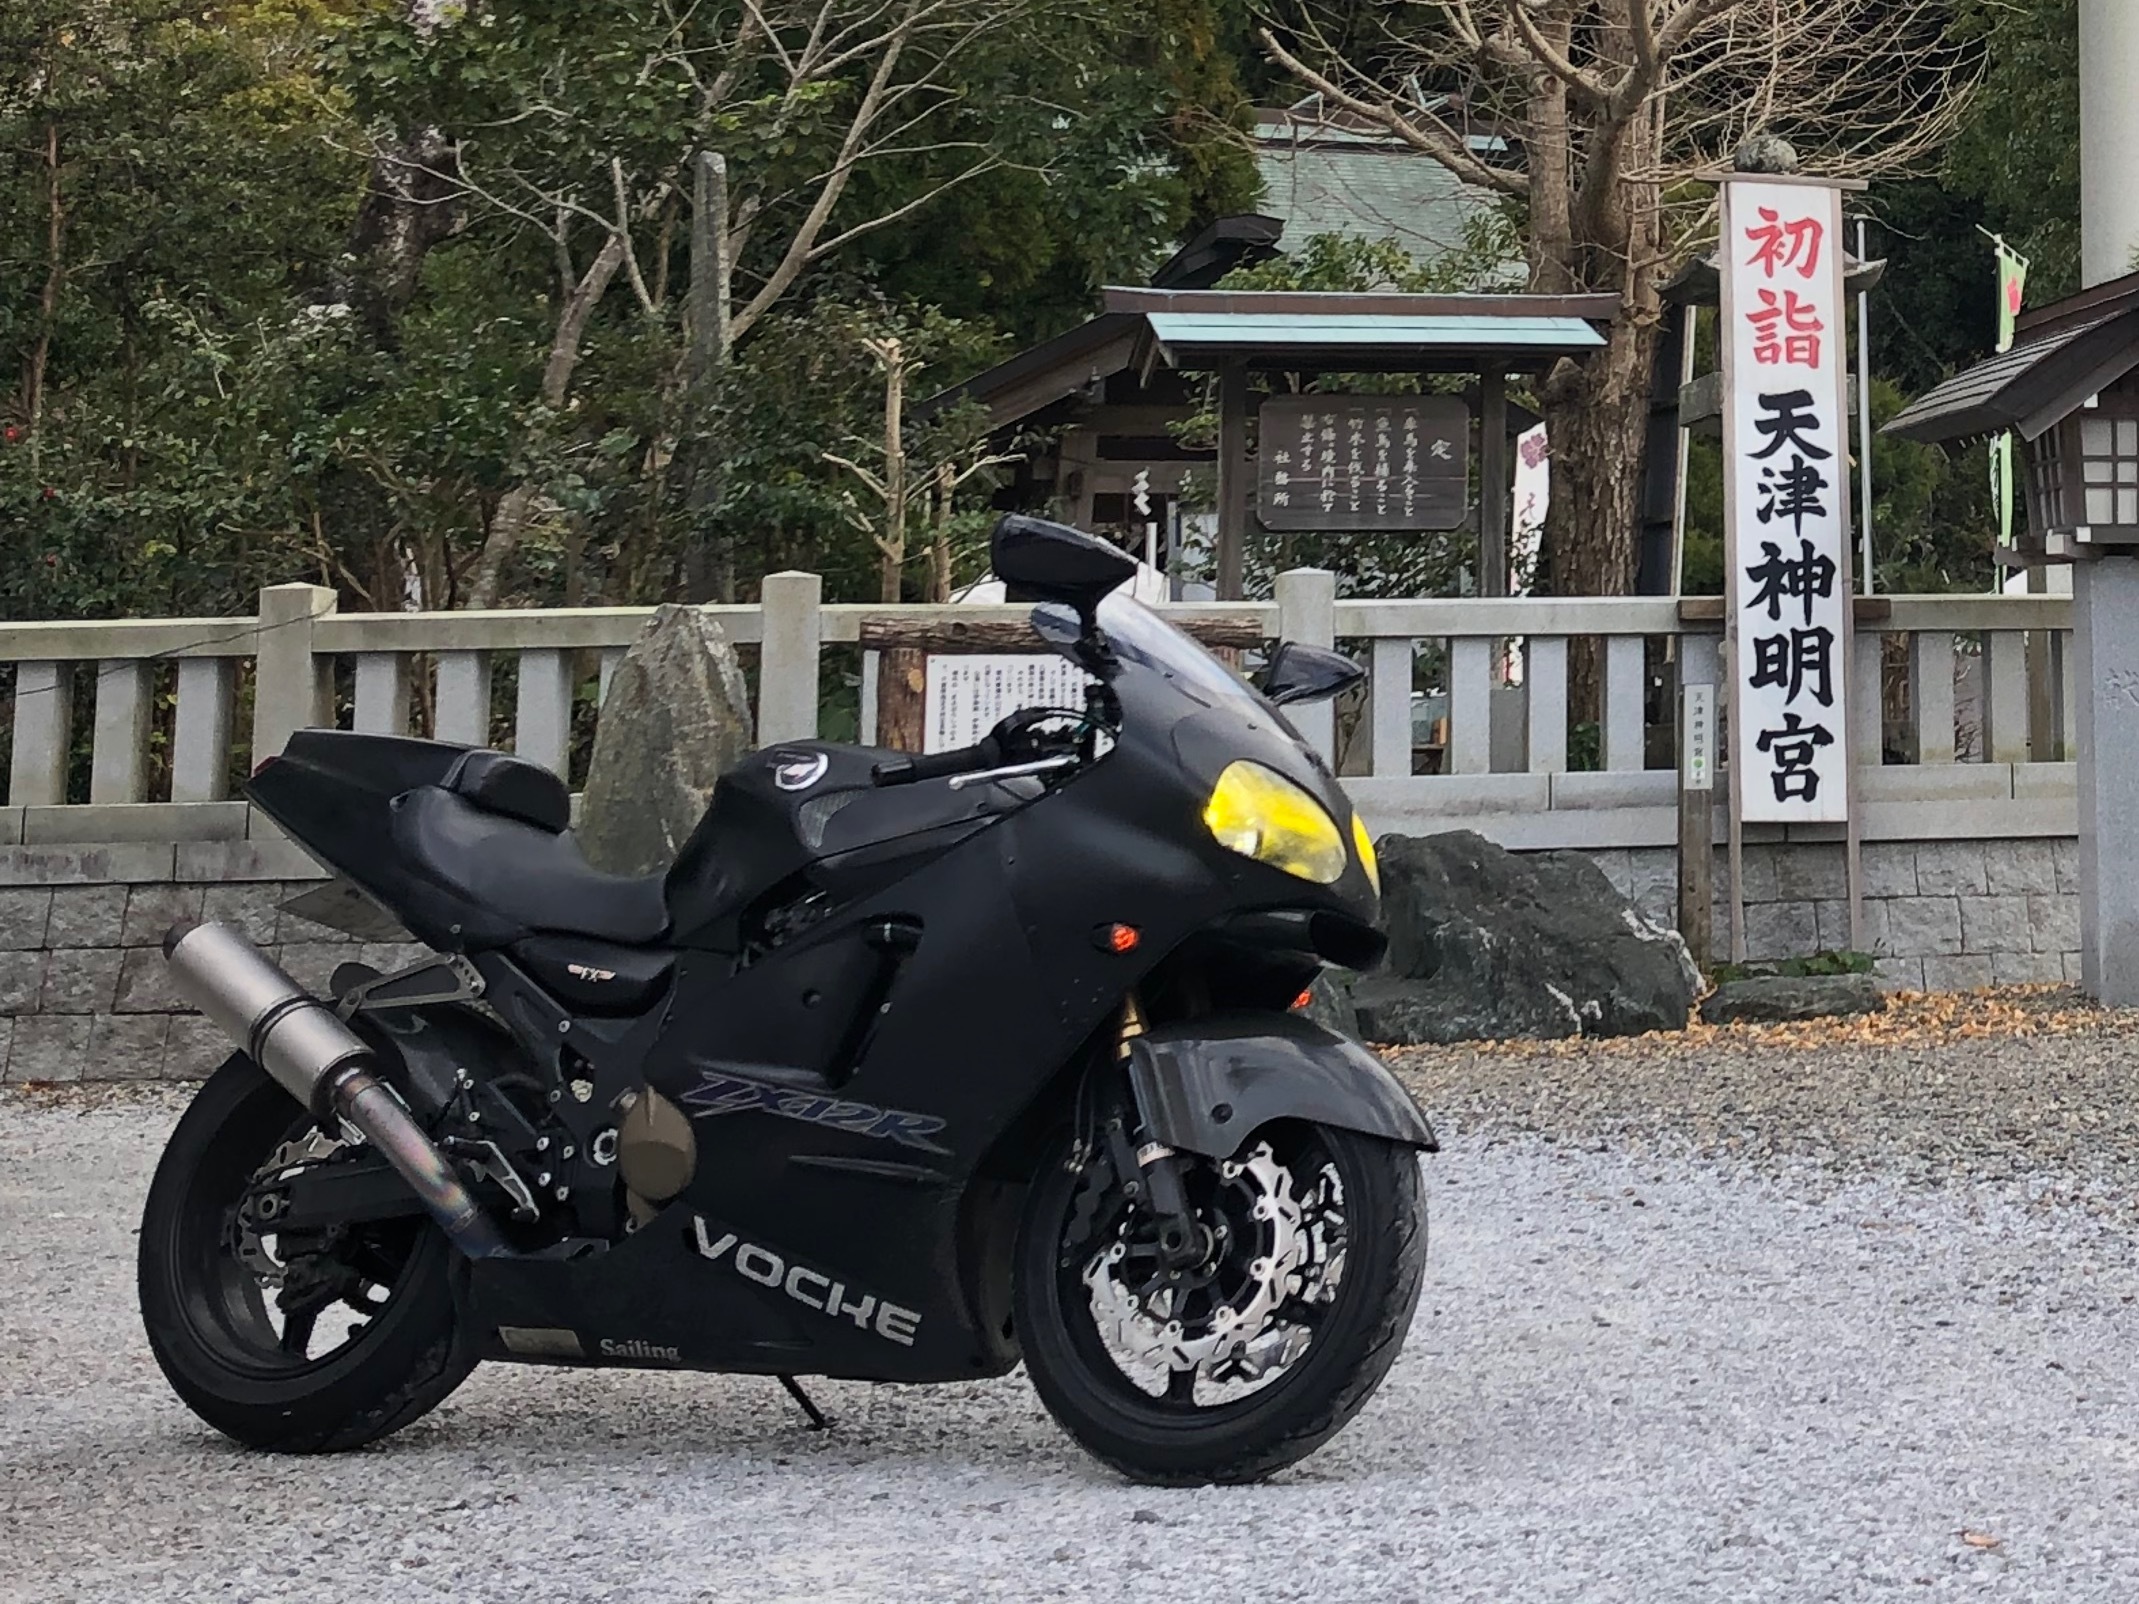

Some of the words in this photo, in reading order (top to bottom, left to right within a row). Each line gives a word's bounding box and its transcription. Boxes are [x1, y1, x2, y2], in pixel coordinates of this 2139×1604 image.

[1745, 206, 1825, 370] 初詣
[1744, 389, 1836, 803] 天津神明宮
[600, 1338, 682, 1361] Sailing
